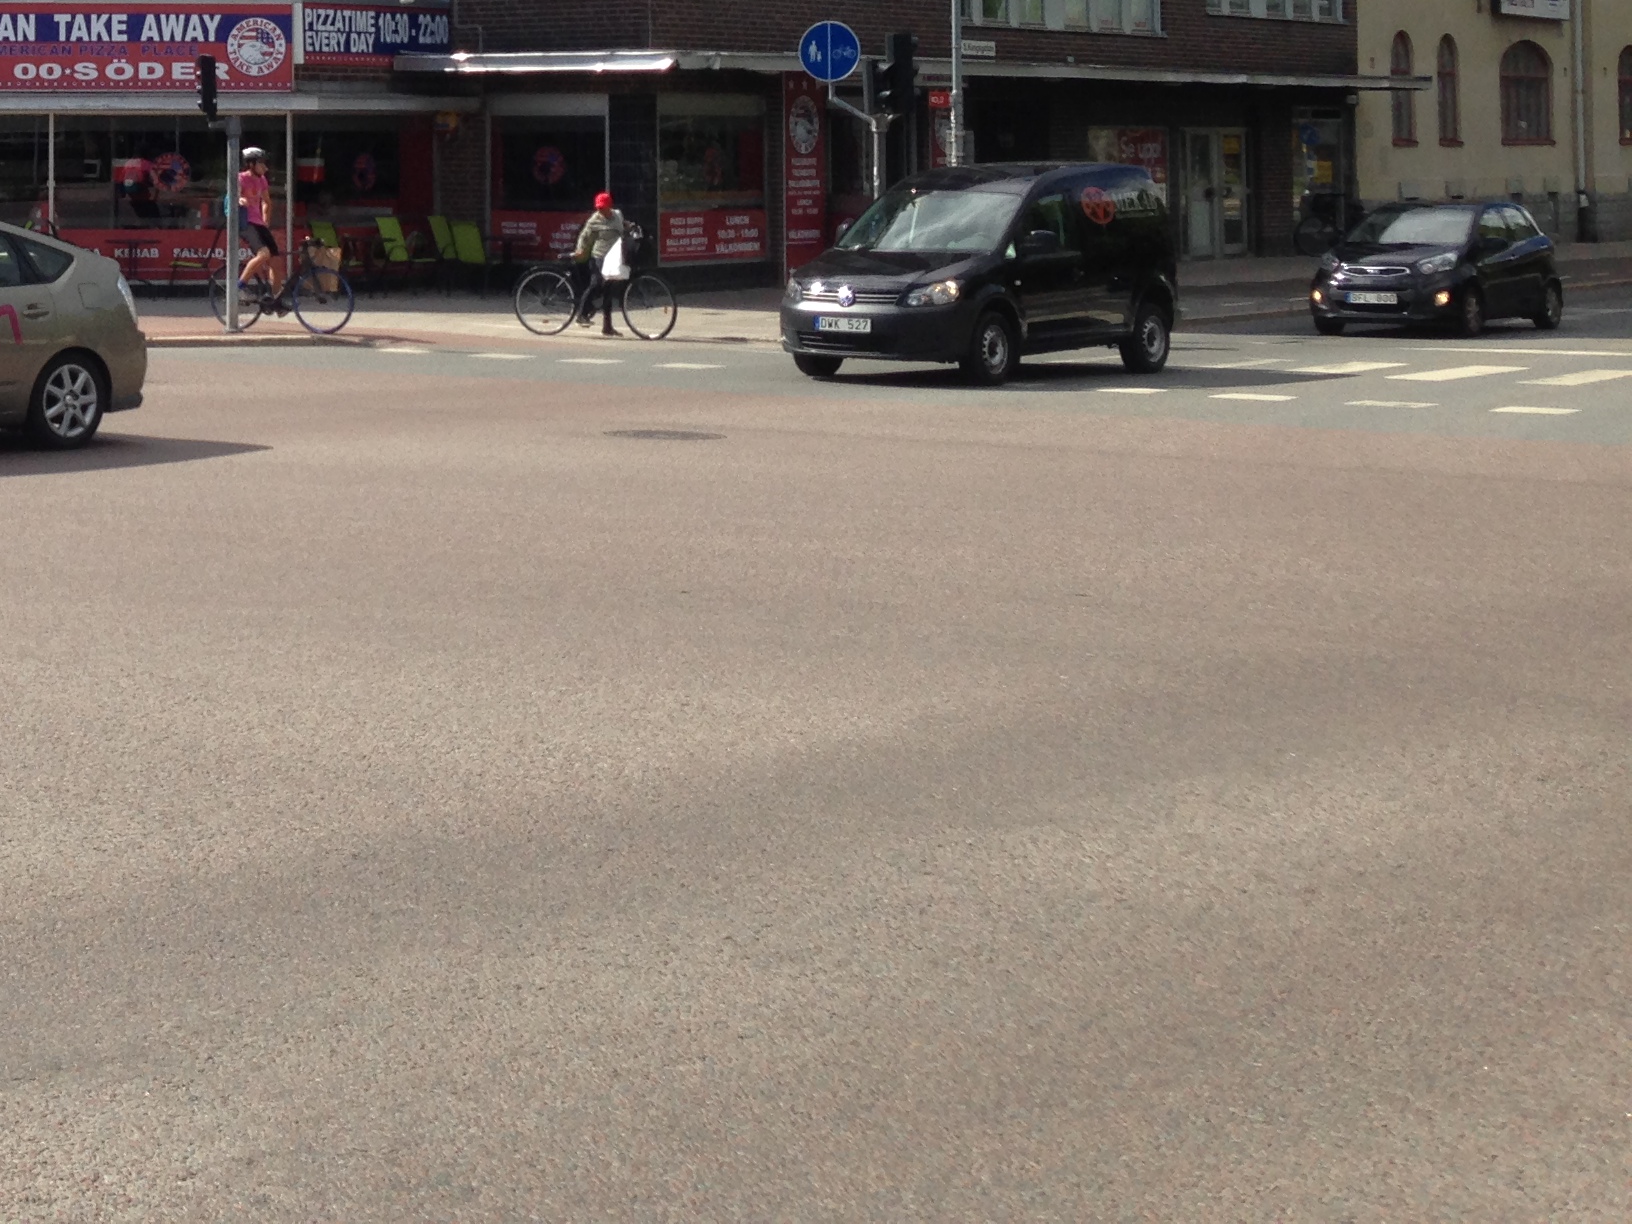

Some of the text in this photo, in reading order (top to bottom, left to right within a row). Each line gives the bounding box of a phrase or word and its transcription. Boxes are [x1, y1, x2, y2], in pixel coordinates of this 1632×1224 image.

[53, 13, 128, 42] TAKE
[140, 13, 221, 42] AWAY
[230, 19, 284, 41] AMERICAN
[304, 8, 376, 33] PIZZATIME
[378, 13, 409, 43] 10:30
[418, 14, 449, 44] 22:00
[79, 44, 128, 57] PIZZA
[141, 44, 199, 57] PLACE
[305, 31, 375, 53] EVERY DAY
[230, 48, 283, 74] TAKE AWAY
[821, 317, 868, 330] DWK 527
